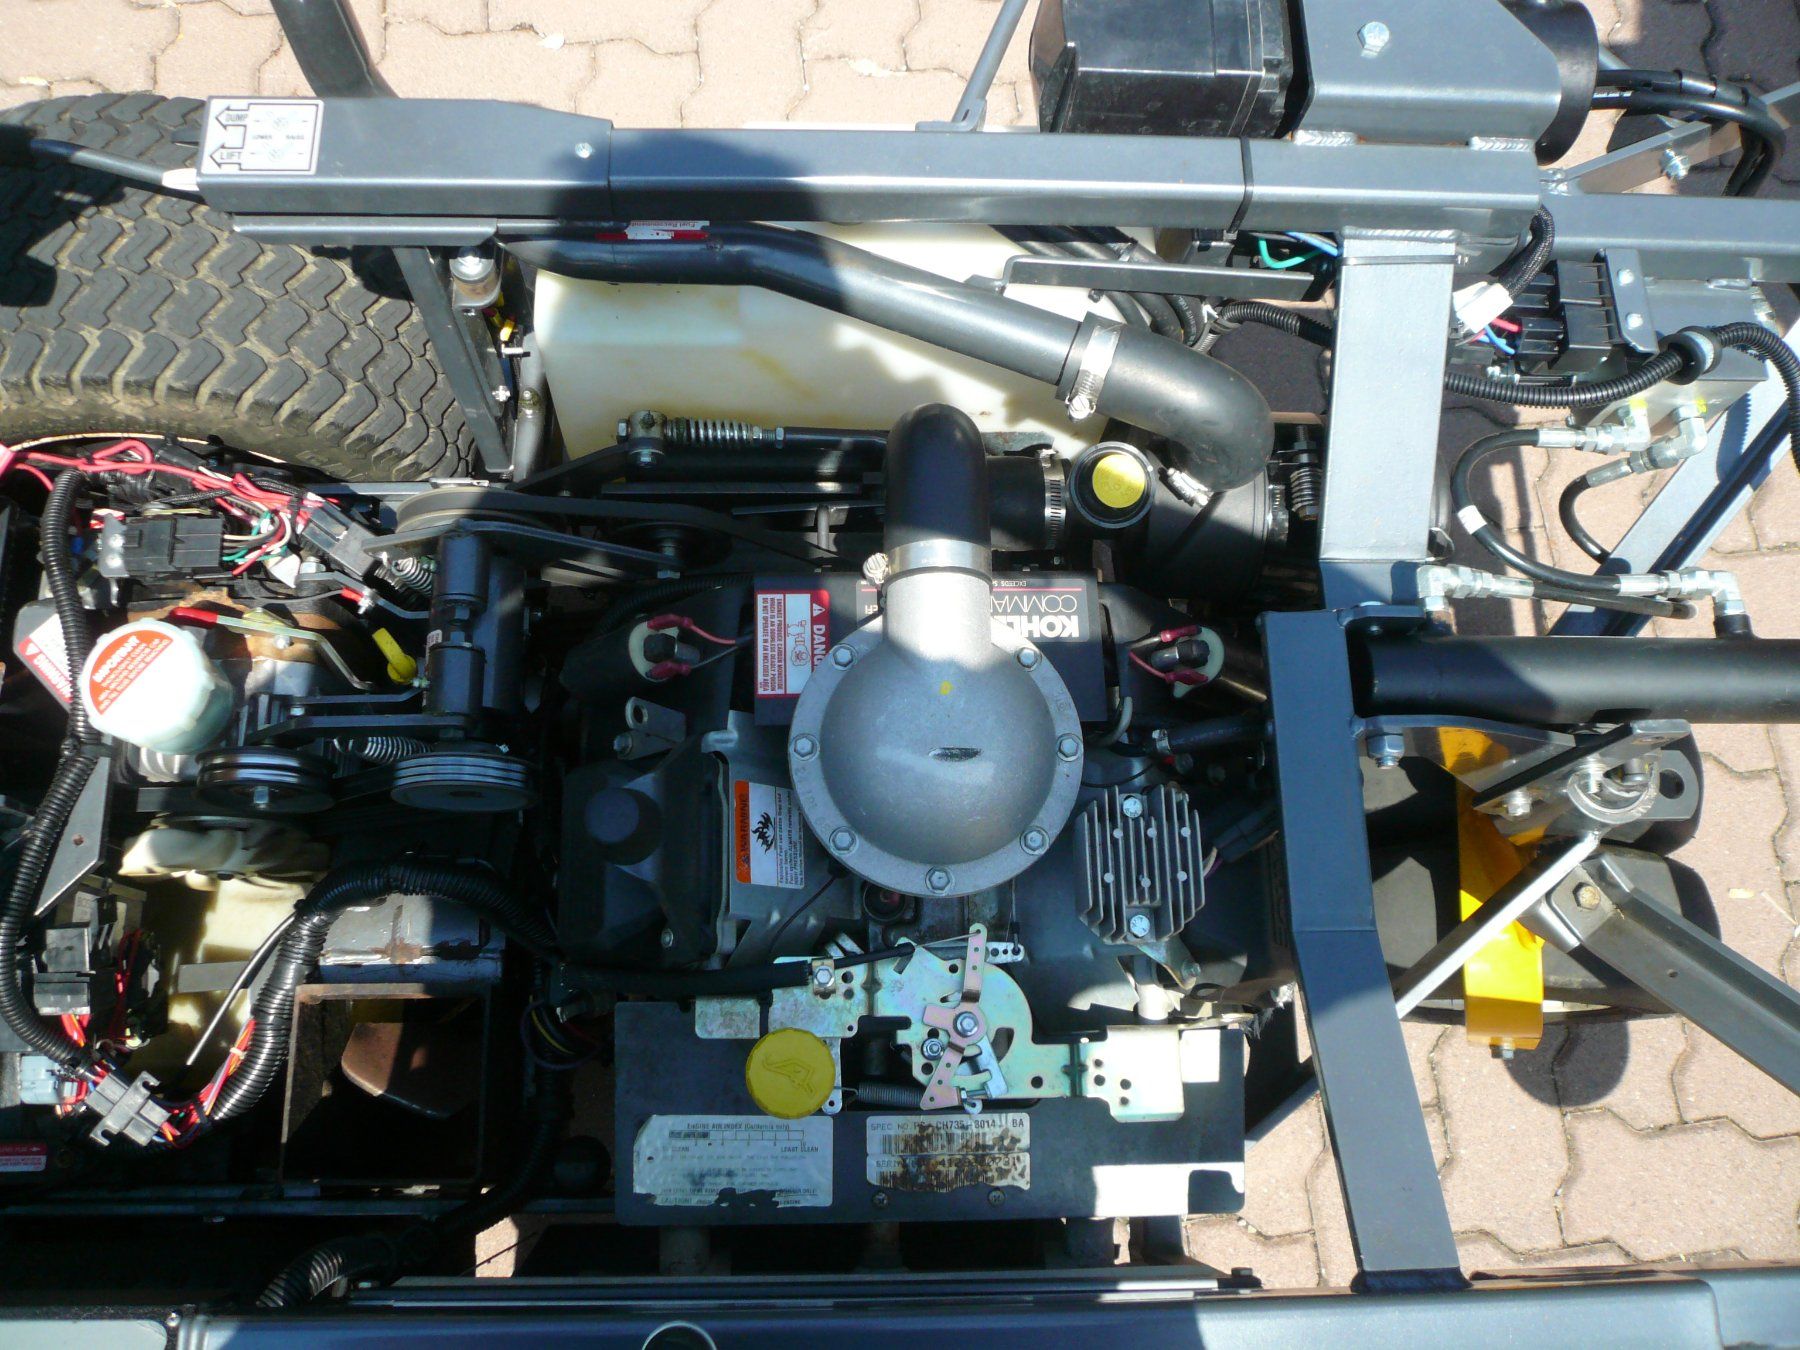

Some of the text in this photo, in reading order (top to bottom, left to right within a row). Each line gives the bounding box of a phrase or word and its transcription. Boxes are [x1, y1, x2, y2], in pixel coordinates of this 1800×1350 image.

[225, 113, 248, 122] DUMP
[220, 152, 241, 160] LIFT
[93, 635, 140, 683] IMPORTANT
[871, 1123, 892, 1131] SPEC
[1012, 1118, 1025, 1128] BA
